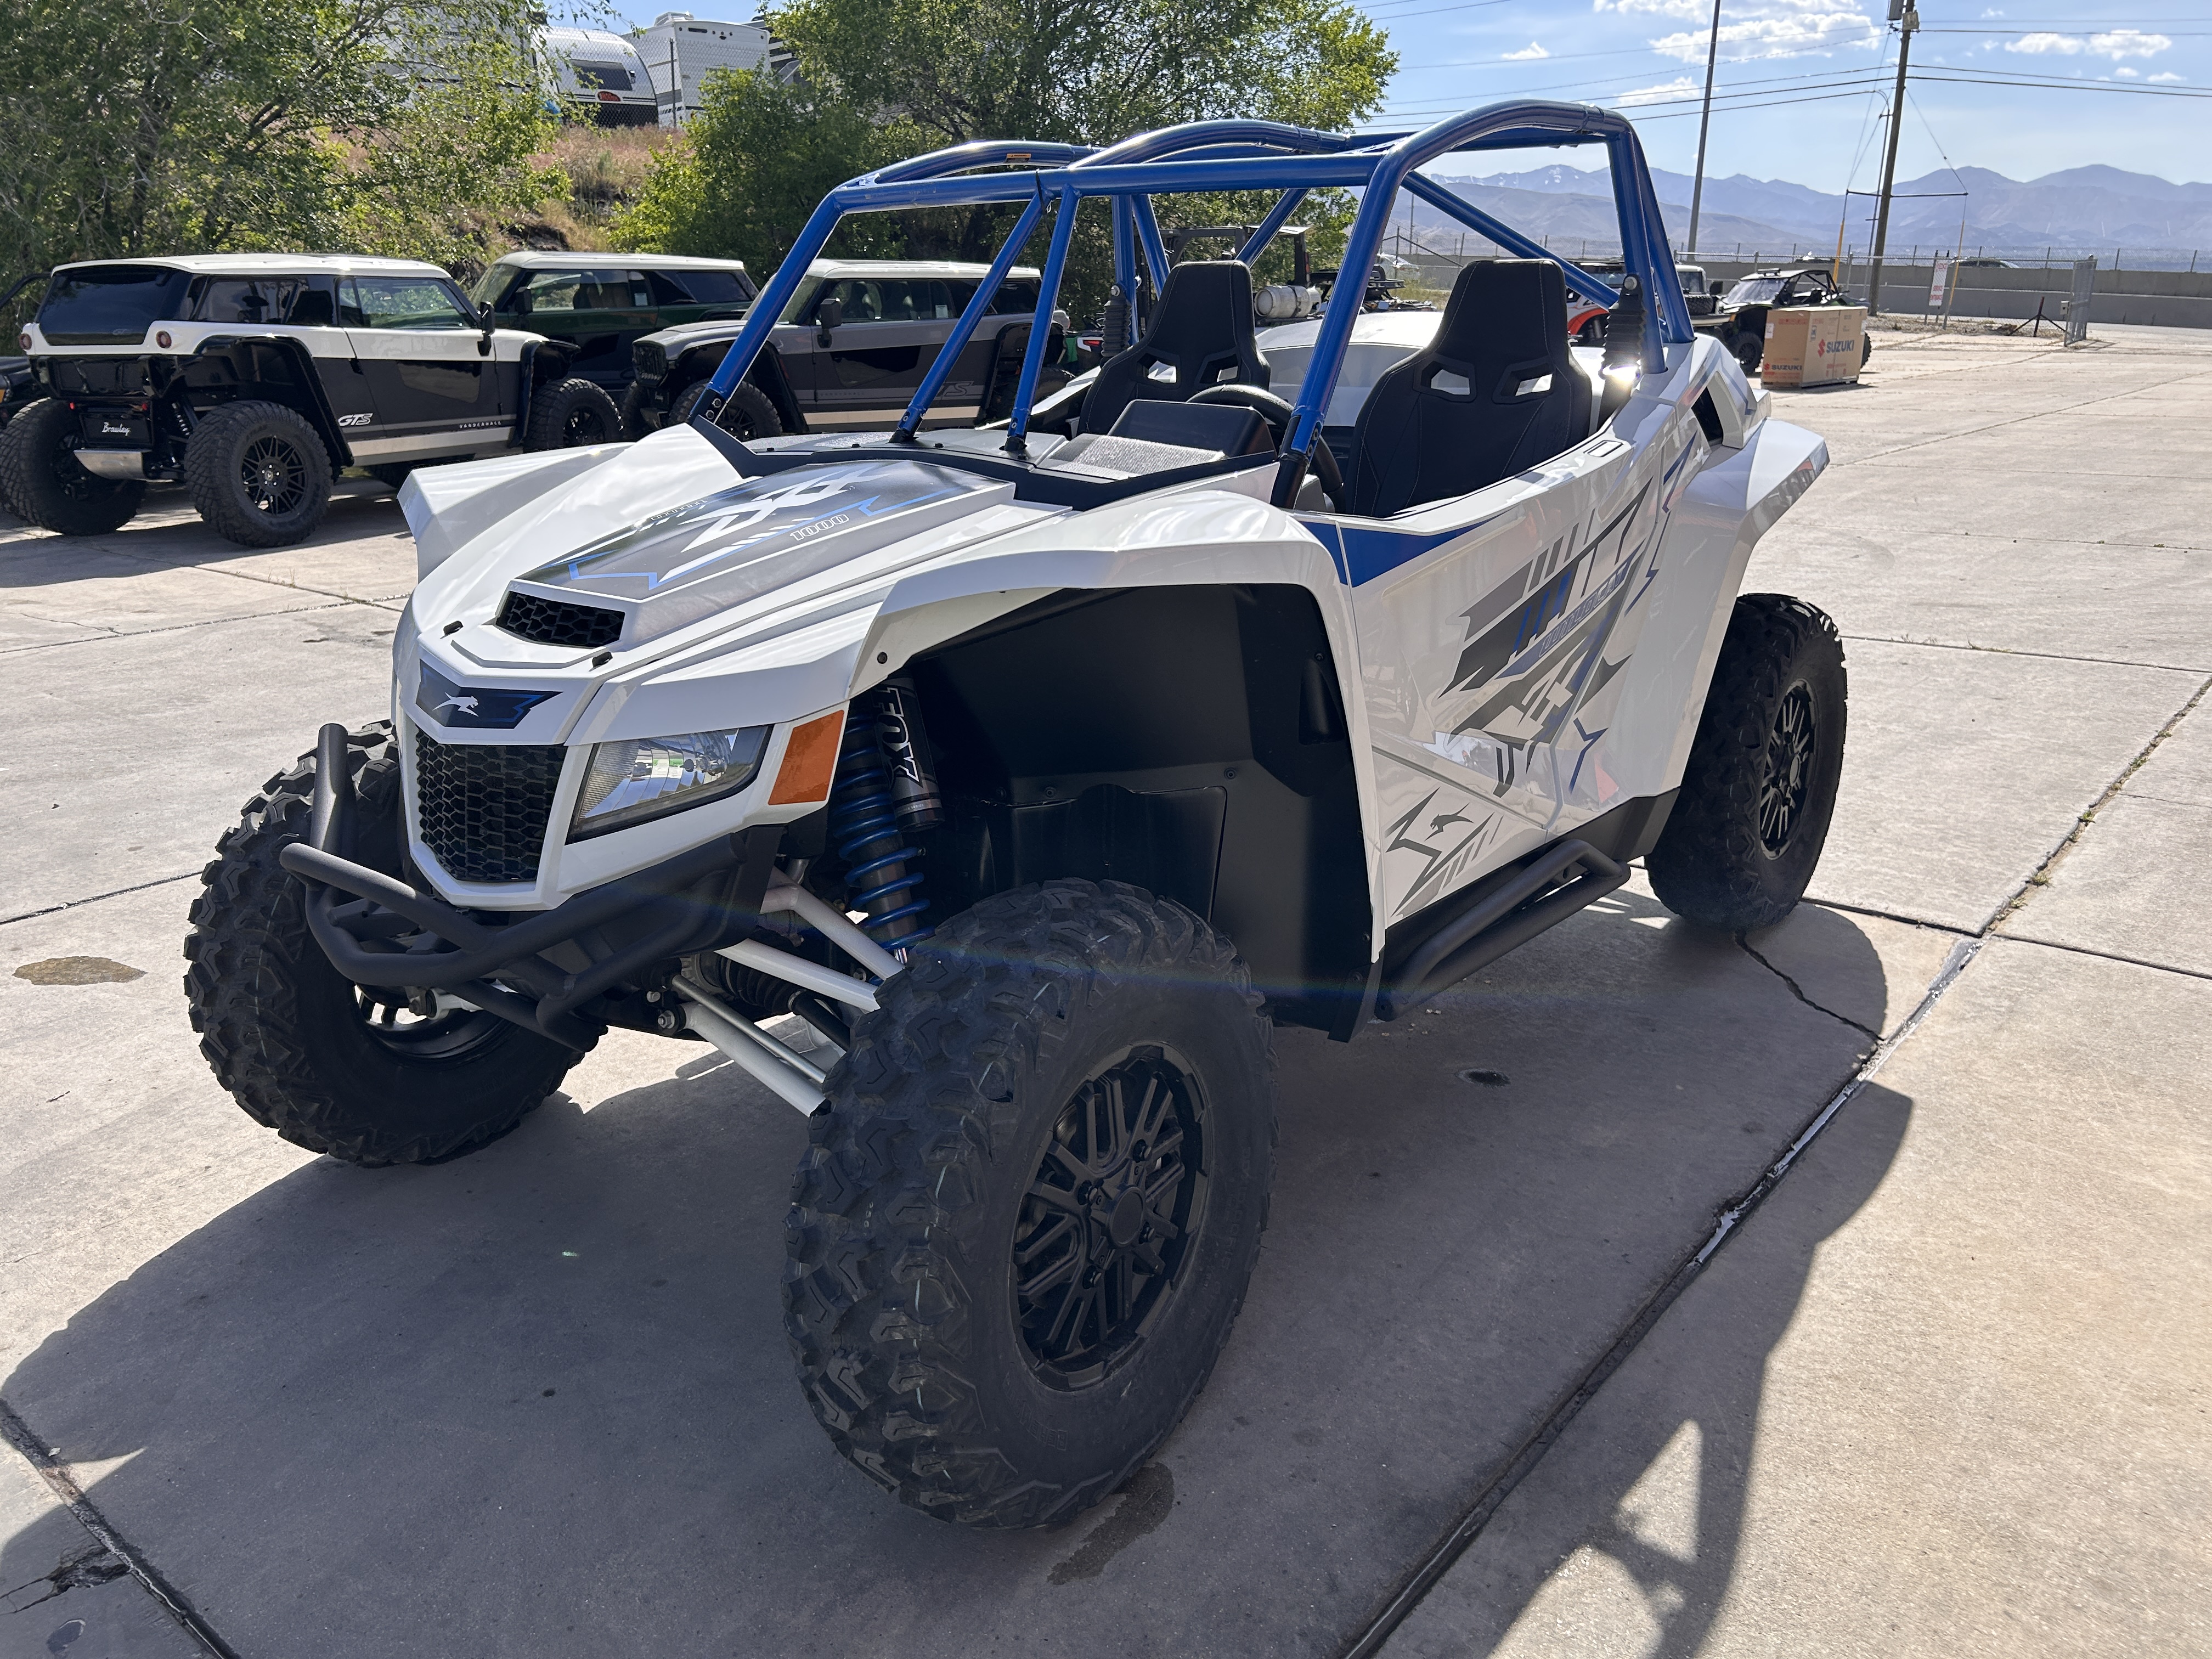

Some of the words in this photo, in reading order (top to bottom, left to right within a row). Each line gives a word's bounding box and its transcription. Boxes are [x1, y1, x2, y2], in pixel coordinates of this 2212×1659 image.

[1826, 340, 1855, 354] SUZUKI
[101, 421, 131, 437] Brawley
[338, 413, 373, 427] GTS
[789, 514, 850, 541] 1000
[1538, 561, 1628, 658] WILDCAT
[873, 686, 921, 786] FOX
